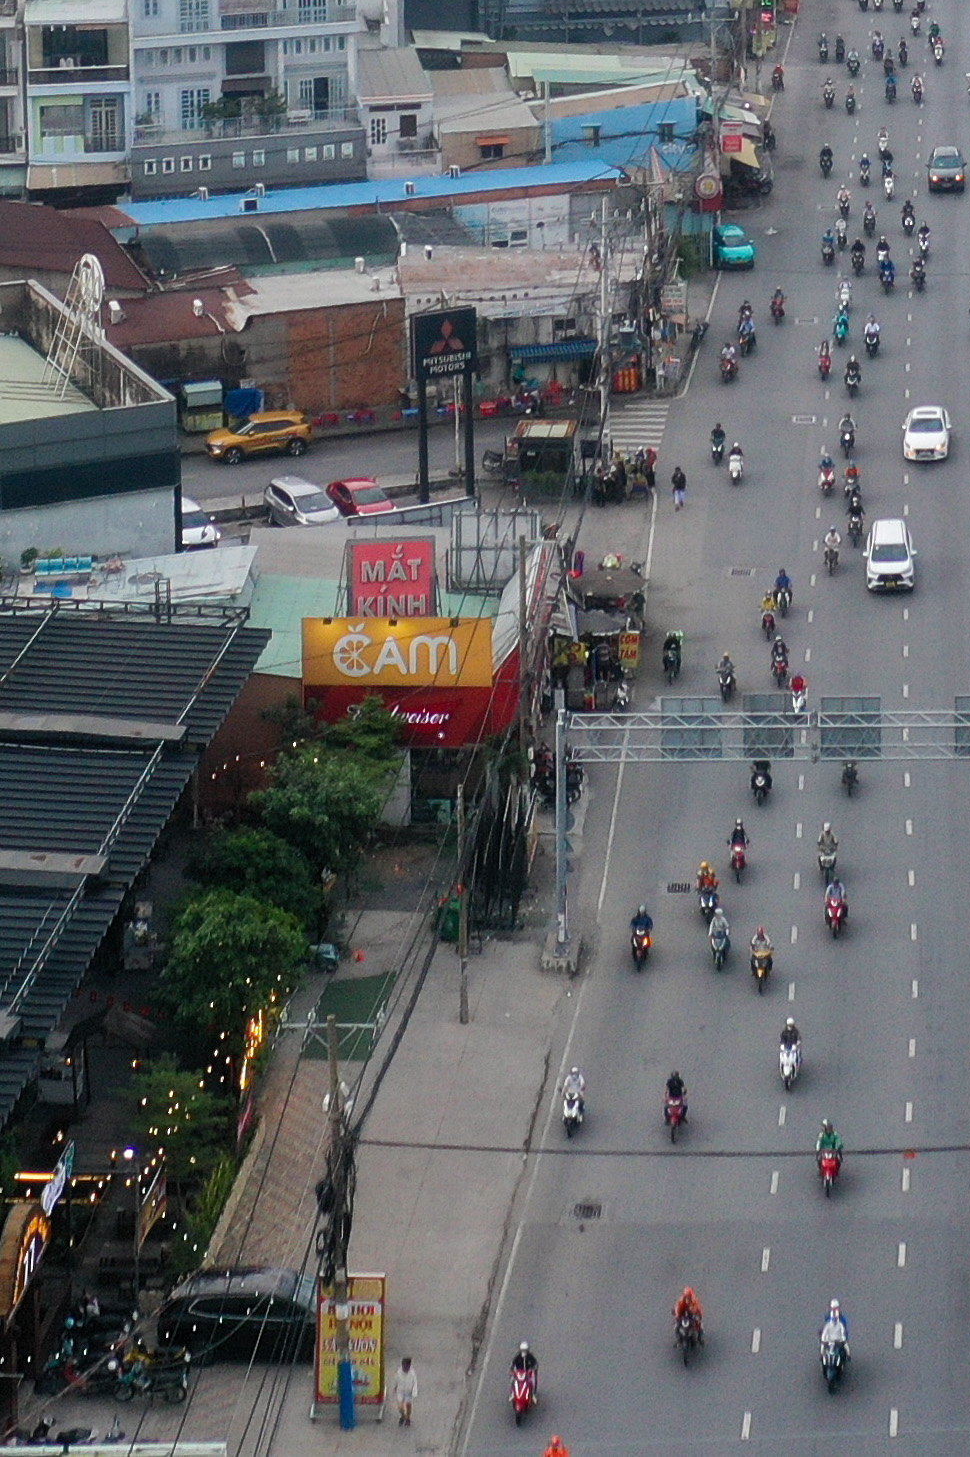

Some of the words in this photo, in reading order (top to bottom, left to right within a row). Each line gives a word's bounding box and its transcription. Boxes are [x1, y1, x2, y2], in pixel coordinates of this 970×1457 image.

[423, 351, 472, 367] MITSUBISHI
[429, 361, 466, 374] MOTORS
[361, 545, 422, 583] MẮT
[357, 584, 427, 617] KÍNH
